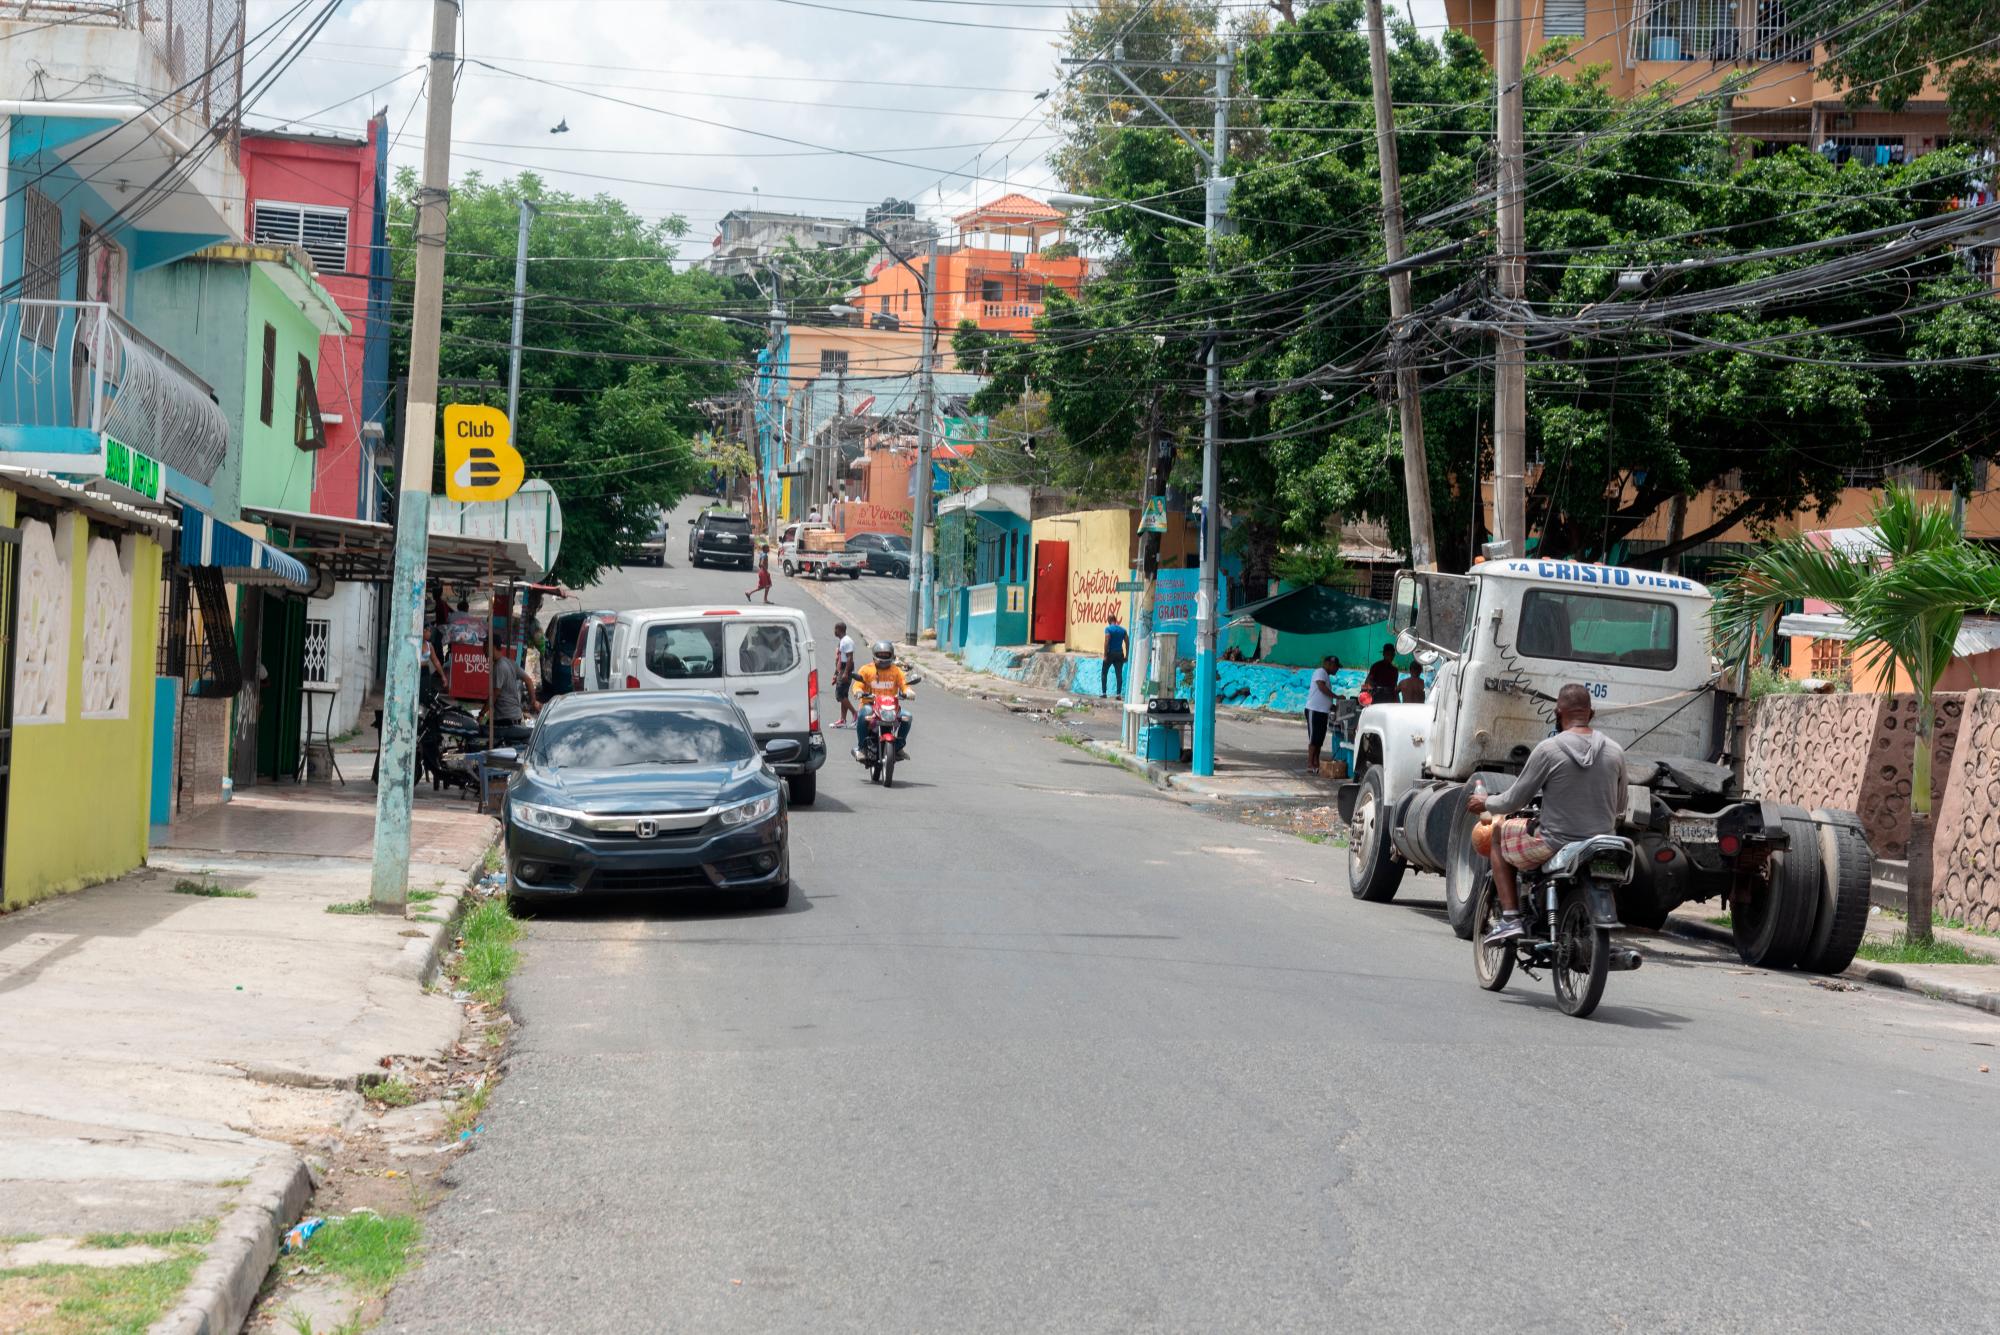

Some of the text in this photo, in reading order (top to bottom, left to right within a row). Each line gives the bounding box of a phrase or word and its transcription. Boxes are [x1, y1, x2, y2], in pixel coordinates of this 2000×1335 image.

[457, 420, 494, 438] Club
[1508, 562, 1693, 591] YA CRISTO VIENE
[1071, 596, 1122, 626] Comedor
[454, 653, 464, 663] LA
[464, 662, 490, 673] DIOS
